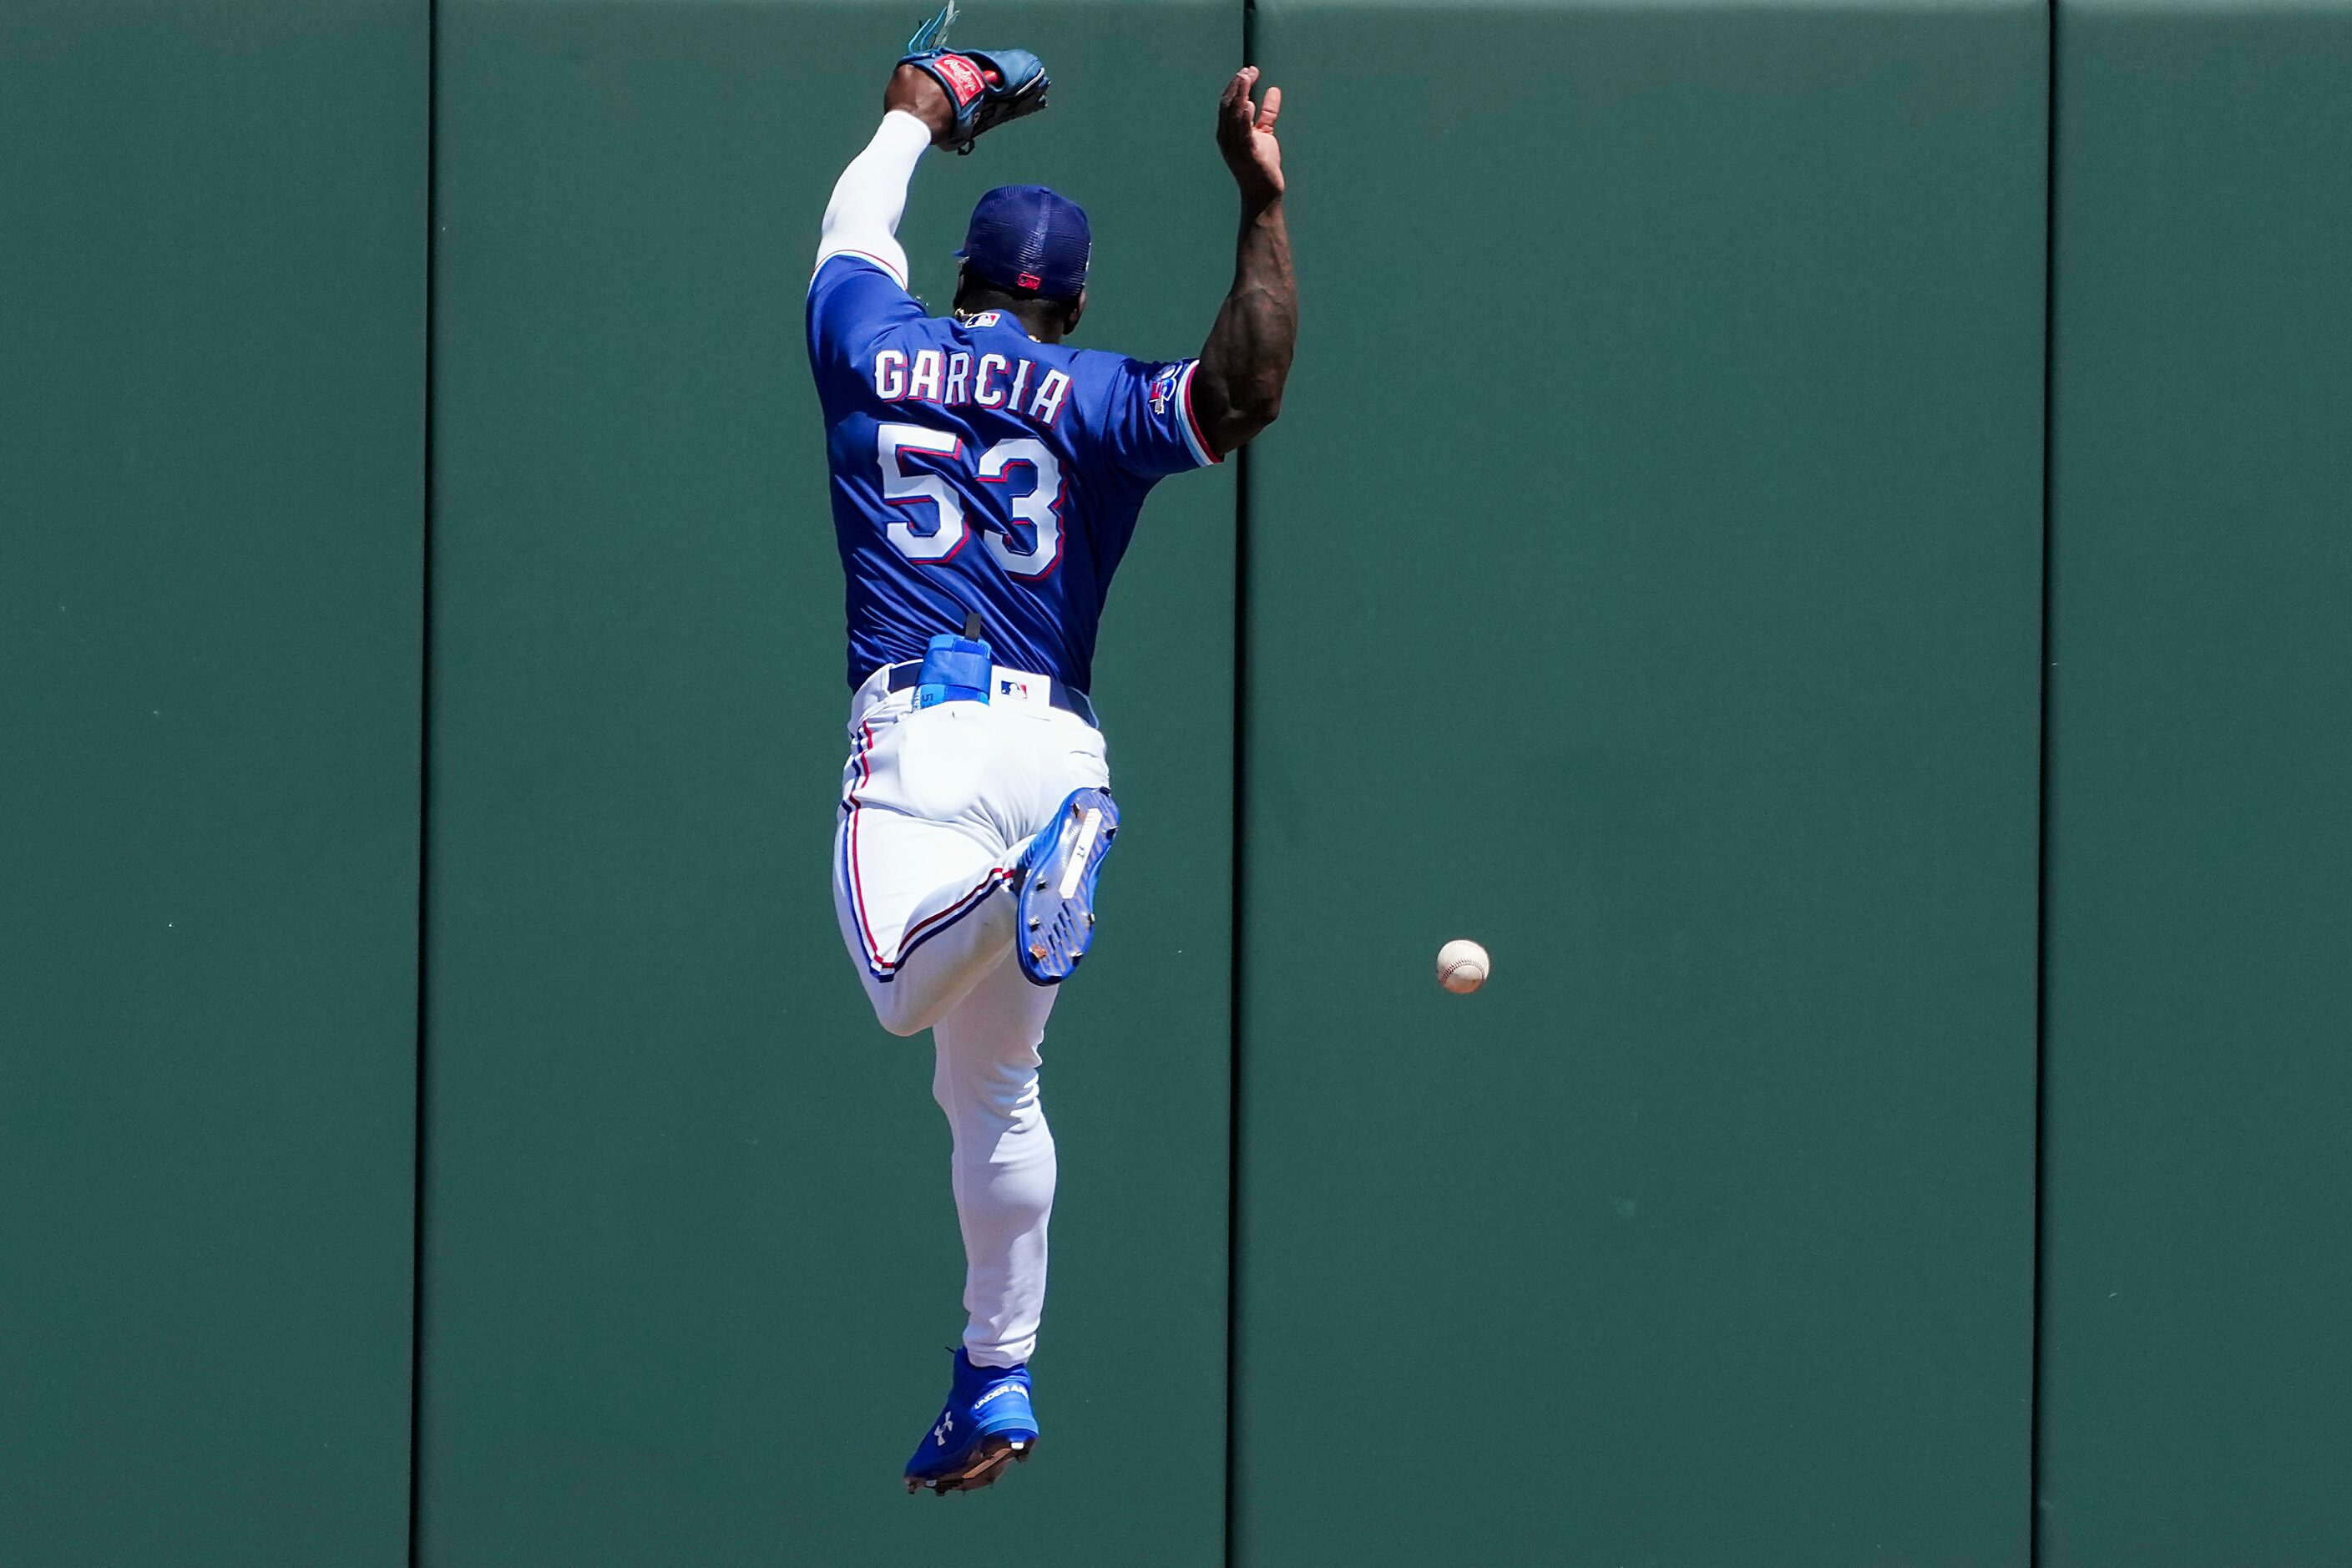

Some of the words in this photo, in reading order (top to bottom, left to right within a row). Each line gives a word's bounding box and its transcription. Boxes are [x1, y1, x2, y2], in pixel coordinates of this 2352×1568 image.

[943, 59, 976, 92] Rawlings
[874, 349, 1073, 429] GARCIA
[876, 422, 1069, 581] 53
[974, 1385, 1009, 1409] UNDER
